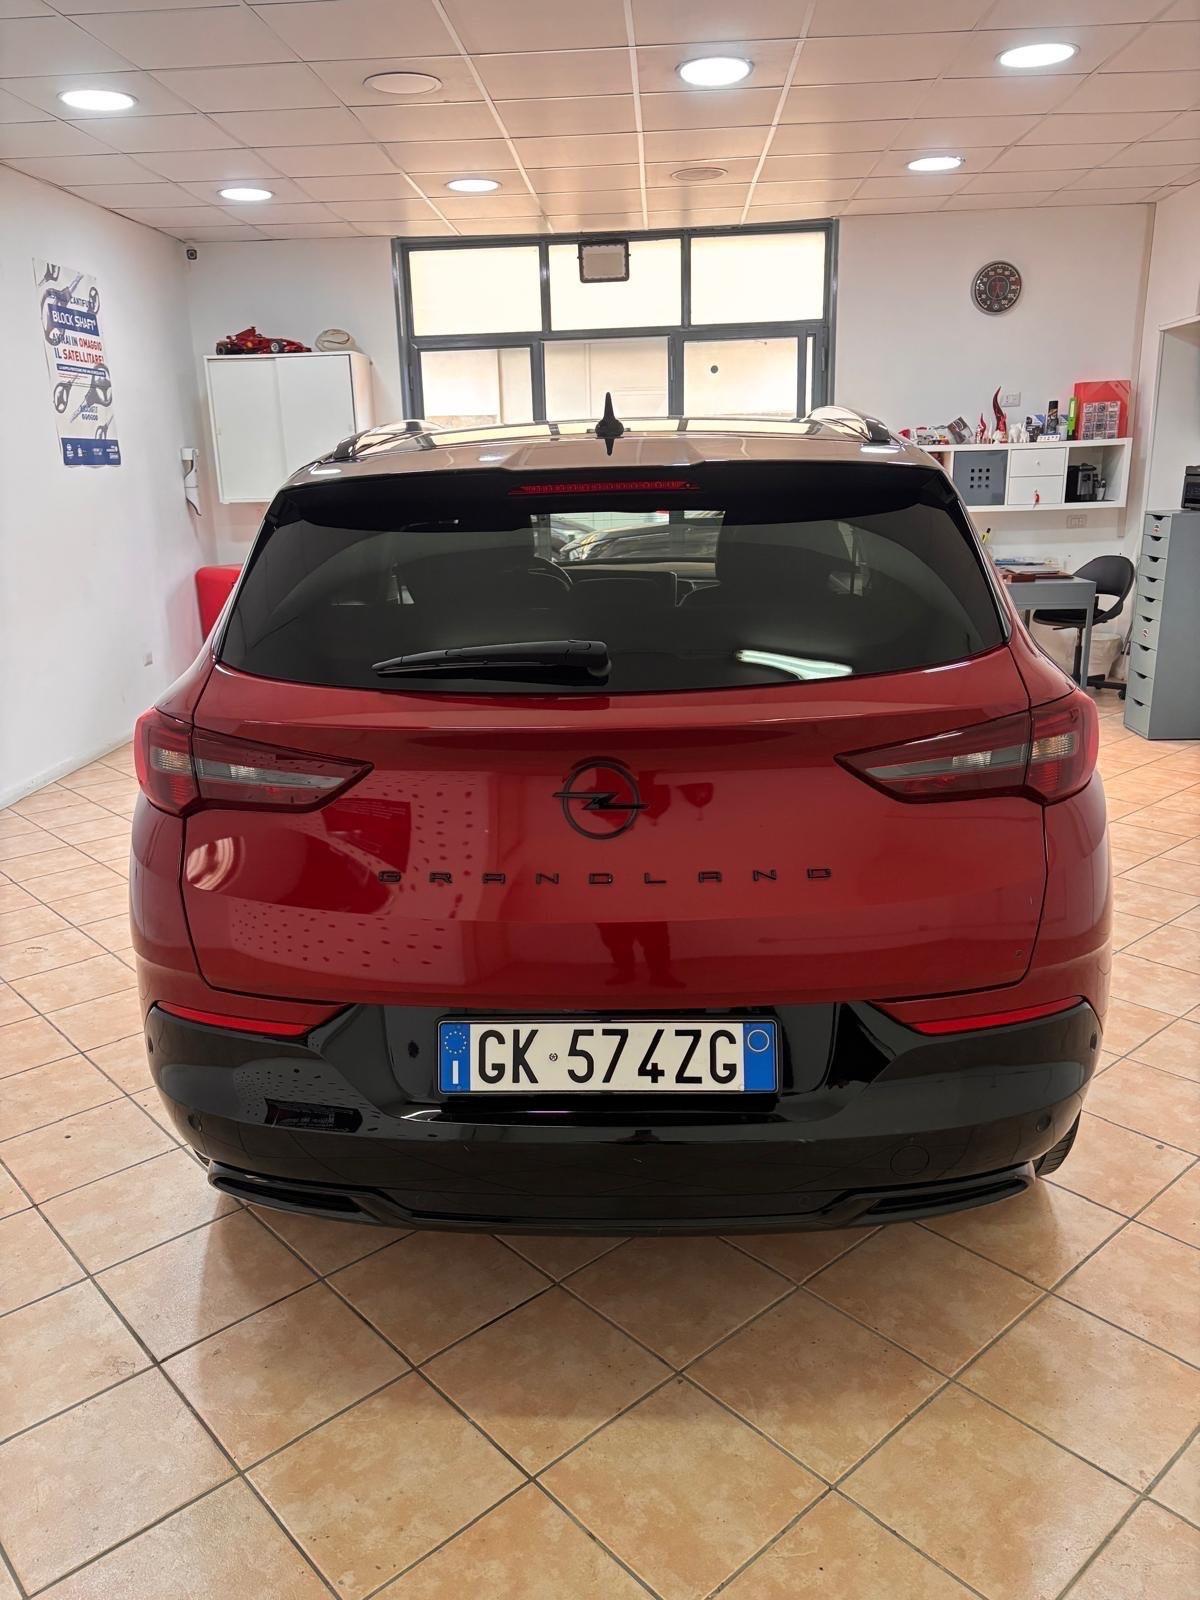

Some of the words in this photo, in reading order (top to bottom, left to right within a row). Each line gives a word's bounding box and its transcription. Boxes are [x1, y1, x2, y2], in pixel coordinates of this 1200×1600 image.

[52, 310, 73, 326] BLOCK
[79, 337, 102, 352] OMAGGIO
[54, 347, 62, 360] IL
[378, 867, 832, 885] GRANDLAND
[478, 1029, 539, 1084] GK
[567, 1028, 737, 1084] 574ZG
